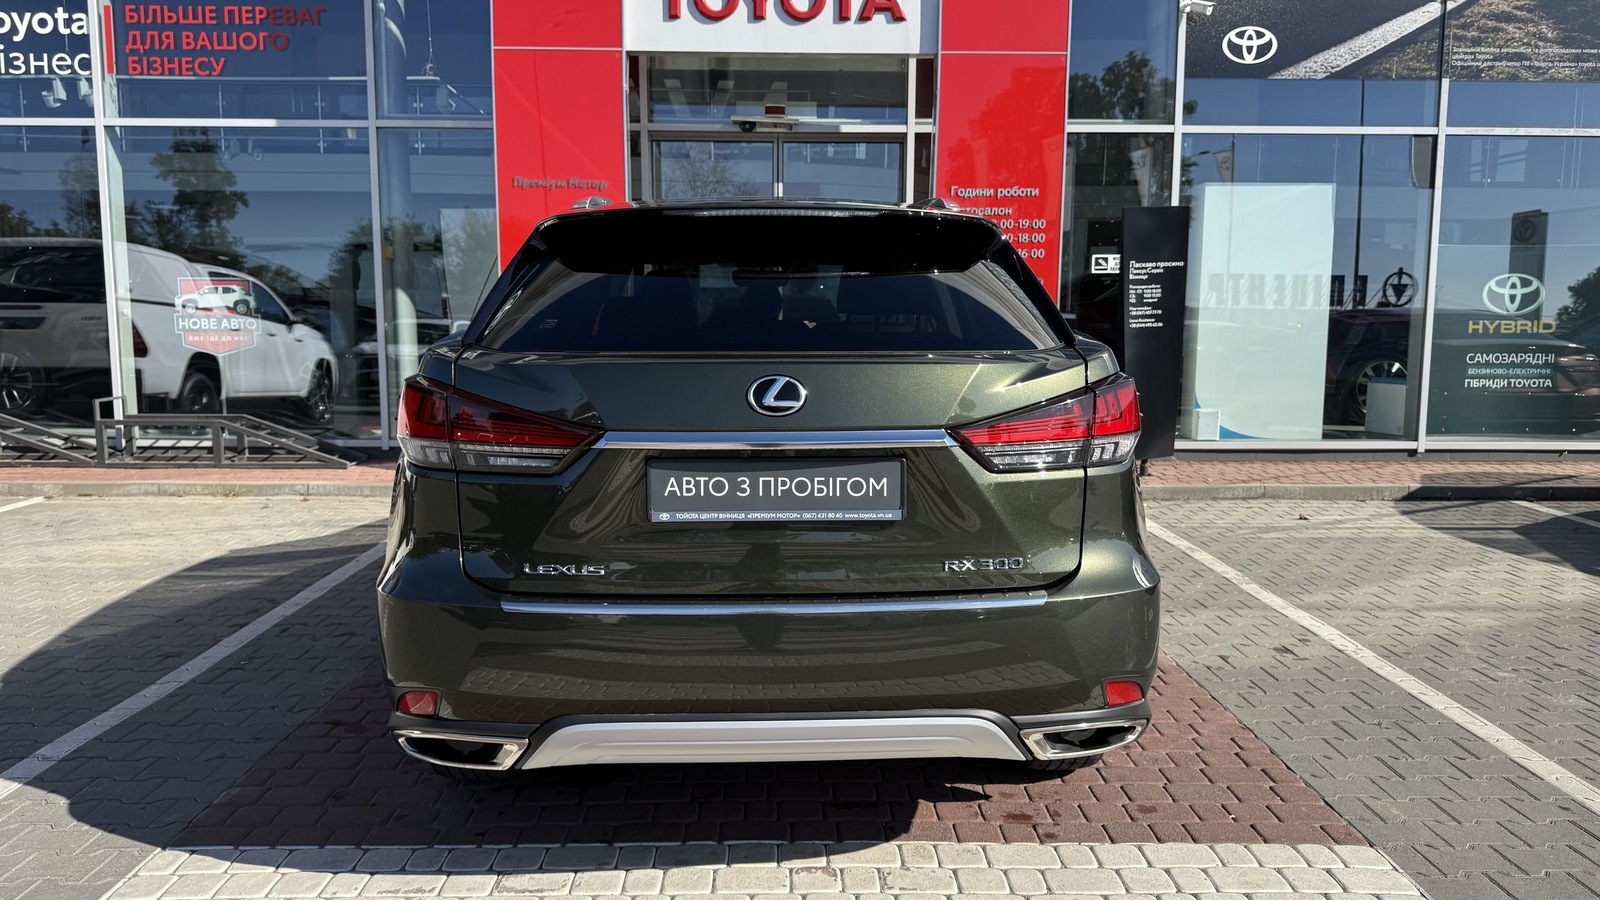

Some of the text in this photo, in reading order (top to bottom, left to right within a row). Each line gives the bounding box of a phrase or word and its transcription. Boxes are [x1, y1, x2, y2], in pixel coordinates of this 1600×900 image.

[124, 5, 326, 26] БІЛЬШЕ ПЕРЕВАГ
[125, 31, 290, 53] ДЛЯ ВАШОГО
[127, 57, 226, 76] БІЗНЕСУ
[567, 177, 608, 192] Мотор
[950, 186, 1039, 200] Години роботи
[961, 207, 1012, 216] тосалон
[179, 318, 257, 329] НОВЕ АВТО
[1467, 320, 1557, 334] HYBRID
[1466, 353, 1555, 365] САМОЗАРЯДНІ
[1464, 379, 1553, 389] ГІБРИДИ TOYOTA
[664, 477, 729, 497] АВТО
[758, 477, 888, 497] ПРОБІГОМ
[699, 512, 718, 520] ЦЕНТР
[719, 512, 745, 520] ВІННИЦЯ
[844, 512, 893, 520] www.toyota.vn.ua
[523, 562, 605, 576] LEXUS
[944, 557, 1024, 572] RX 300
